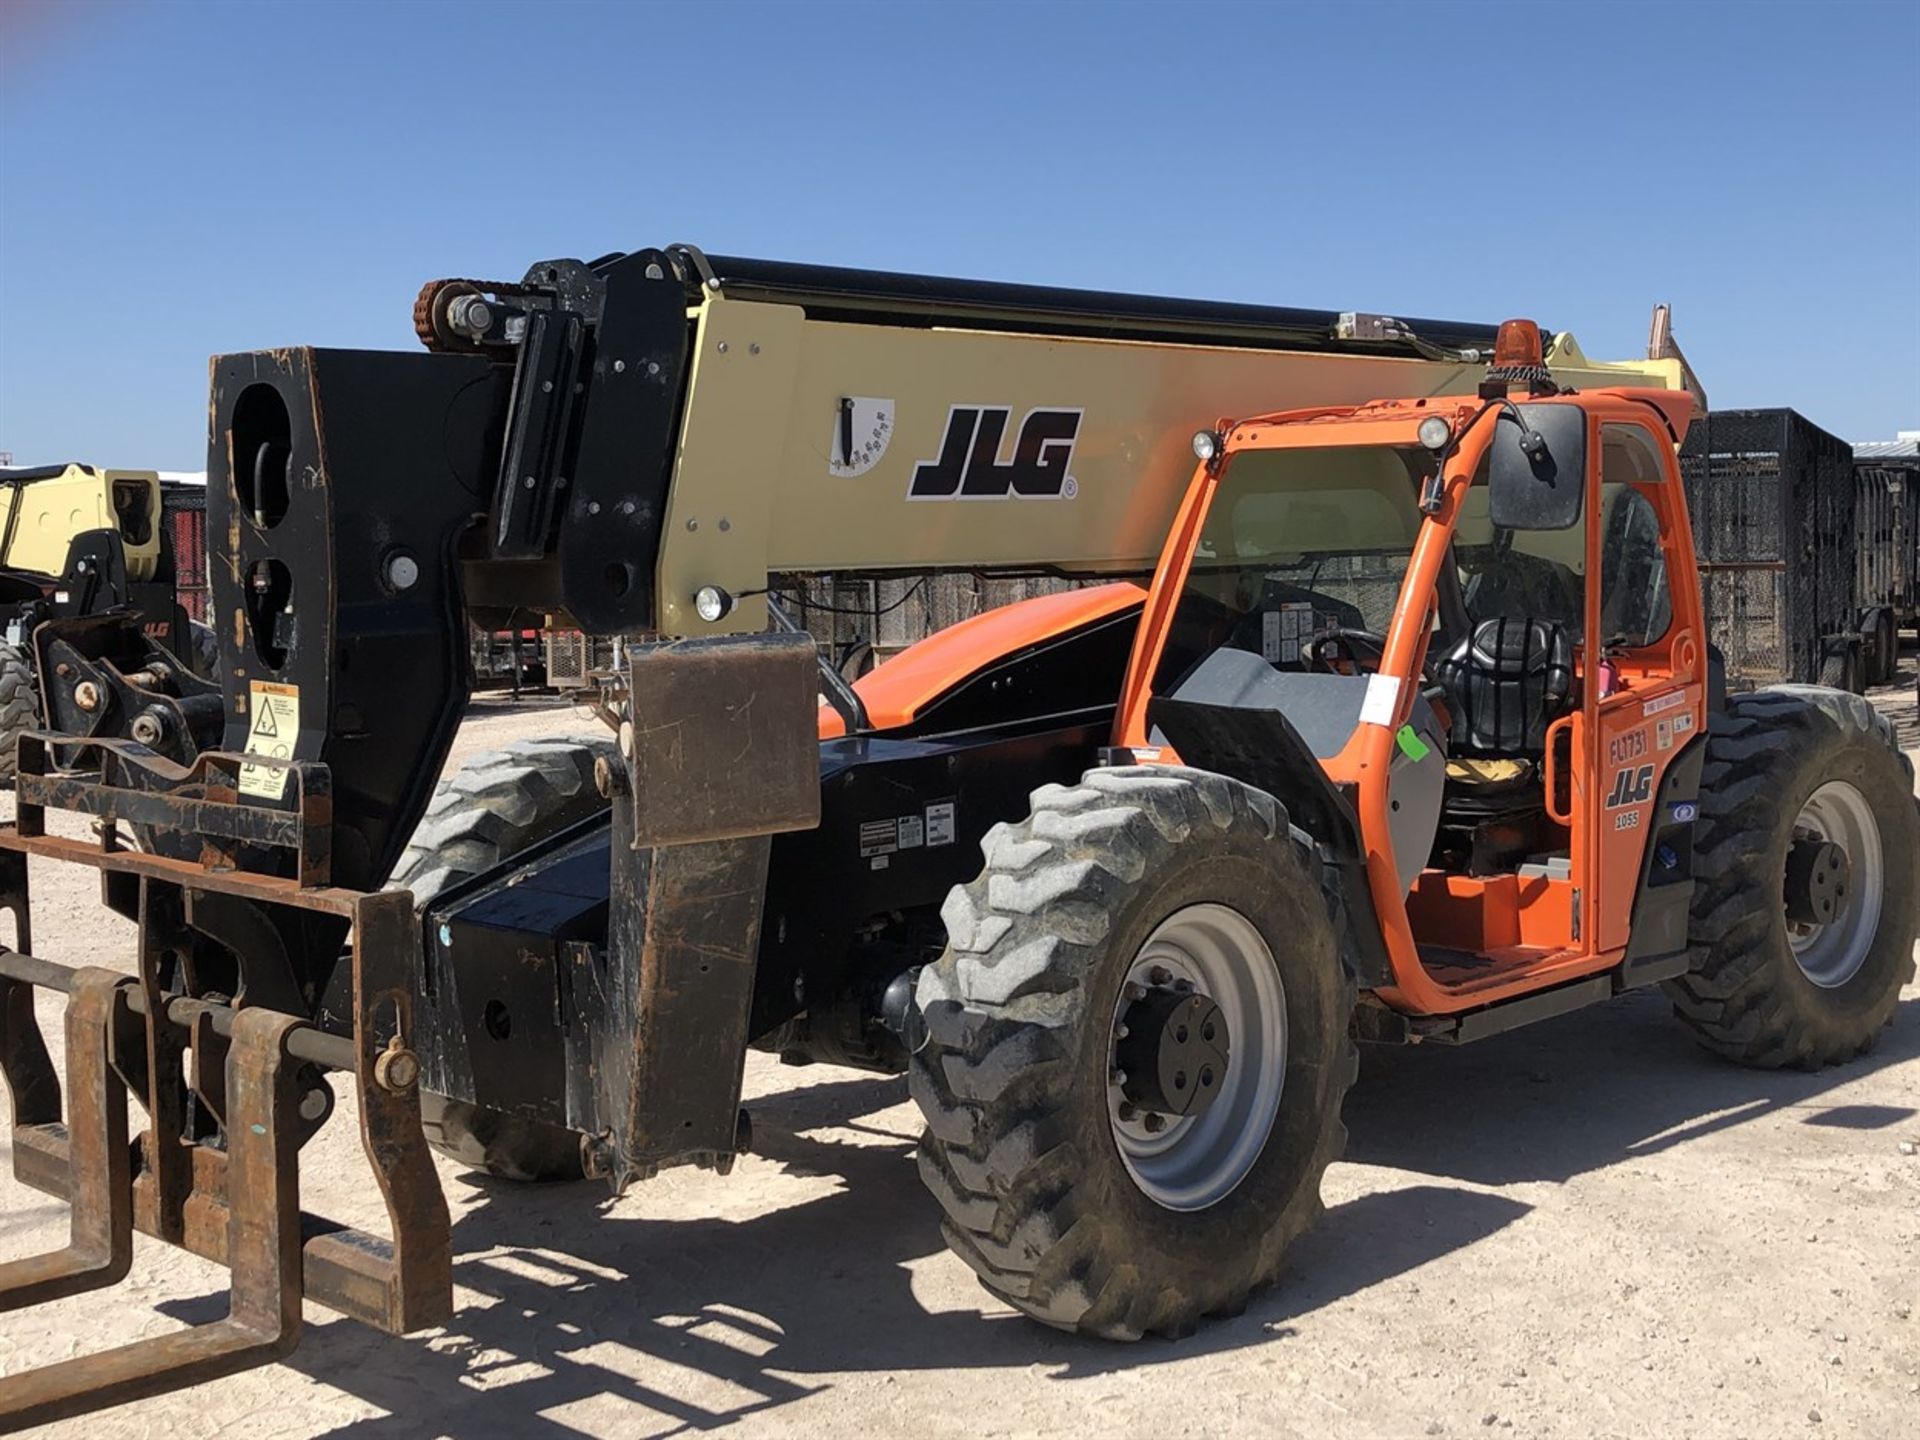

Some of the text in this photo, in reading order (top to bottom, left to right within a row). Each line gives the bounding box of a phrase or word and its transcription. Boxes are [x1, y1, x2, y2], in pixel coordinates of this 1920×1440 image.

[909, 406, 1081, 498] JLG
[1607, 764, 1655, 809] JLG
[1616, 811, 1639, 829] 1055
